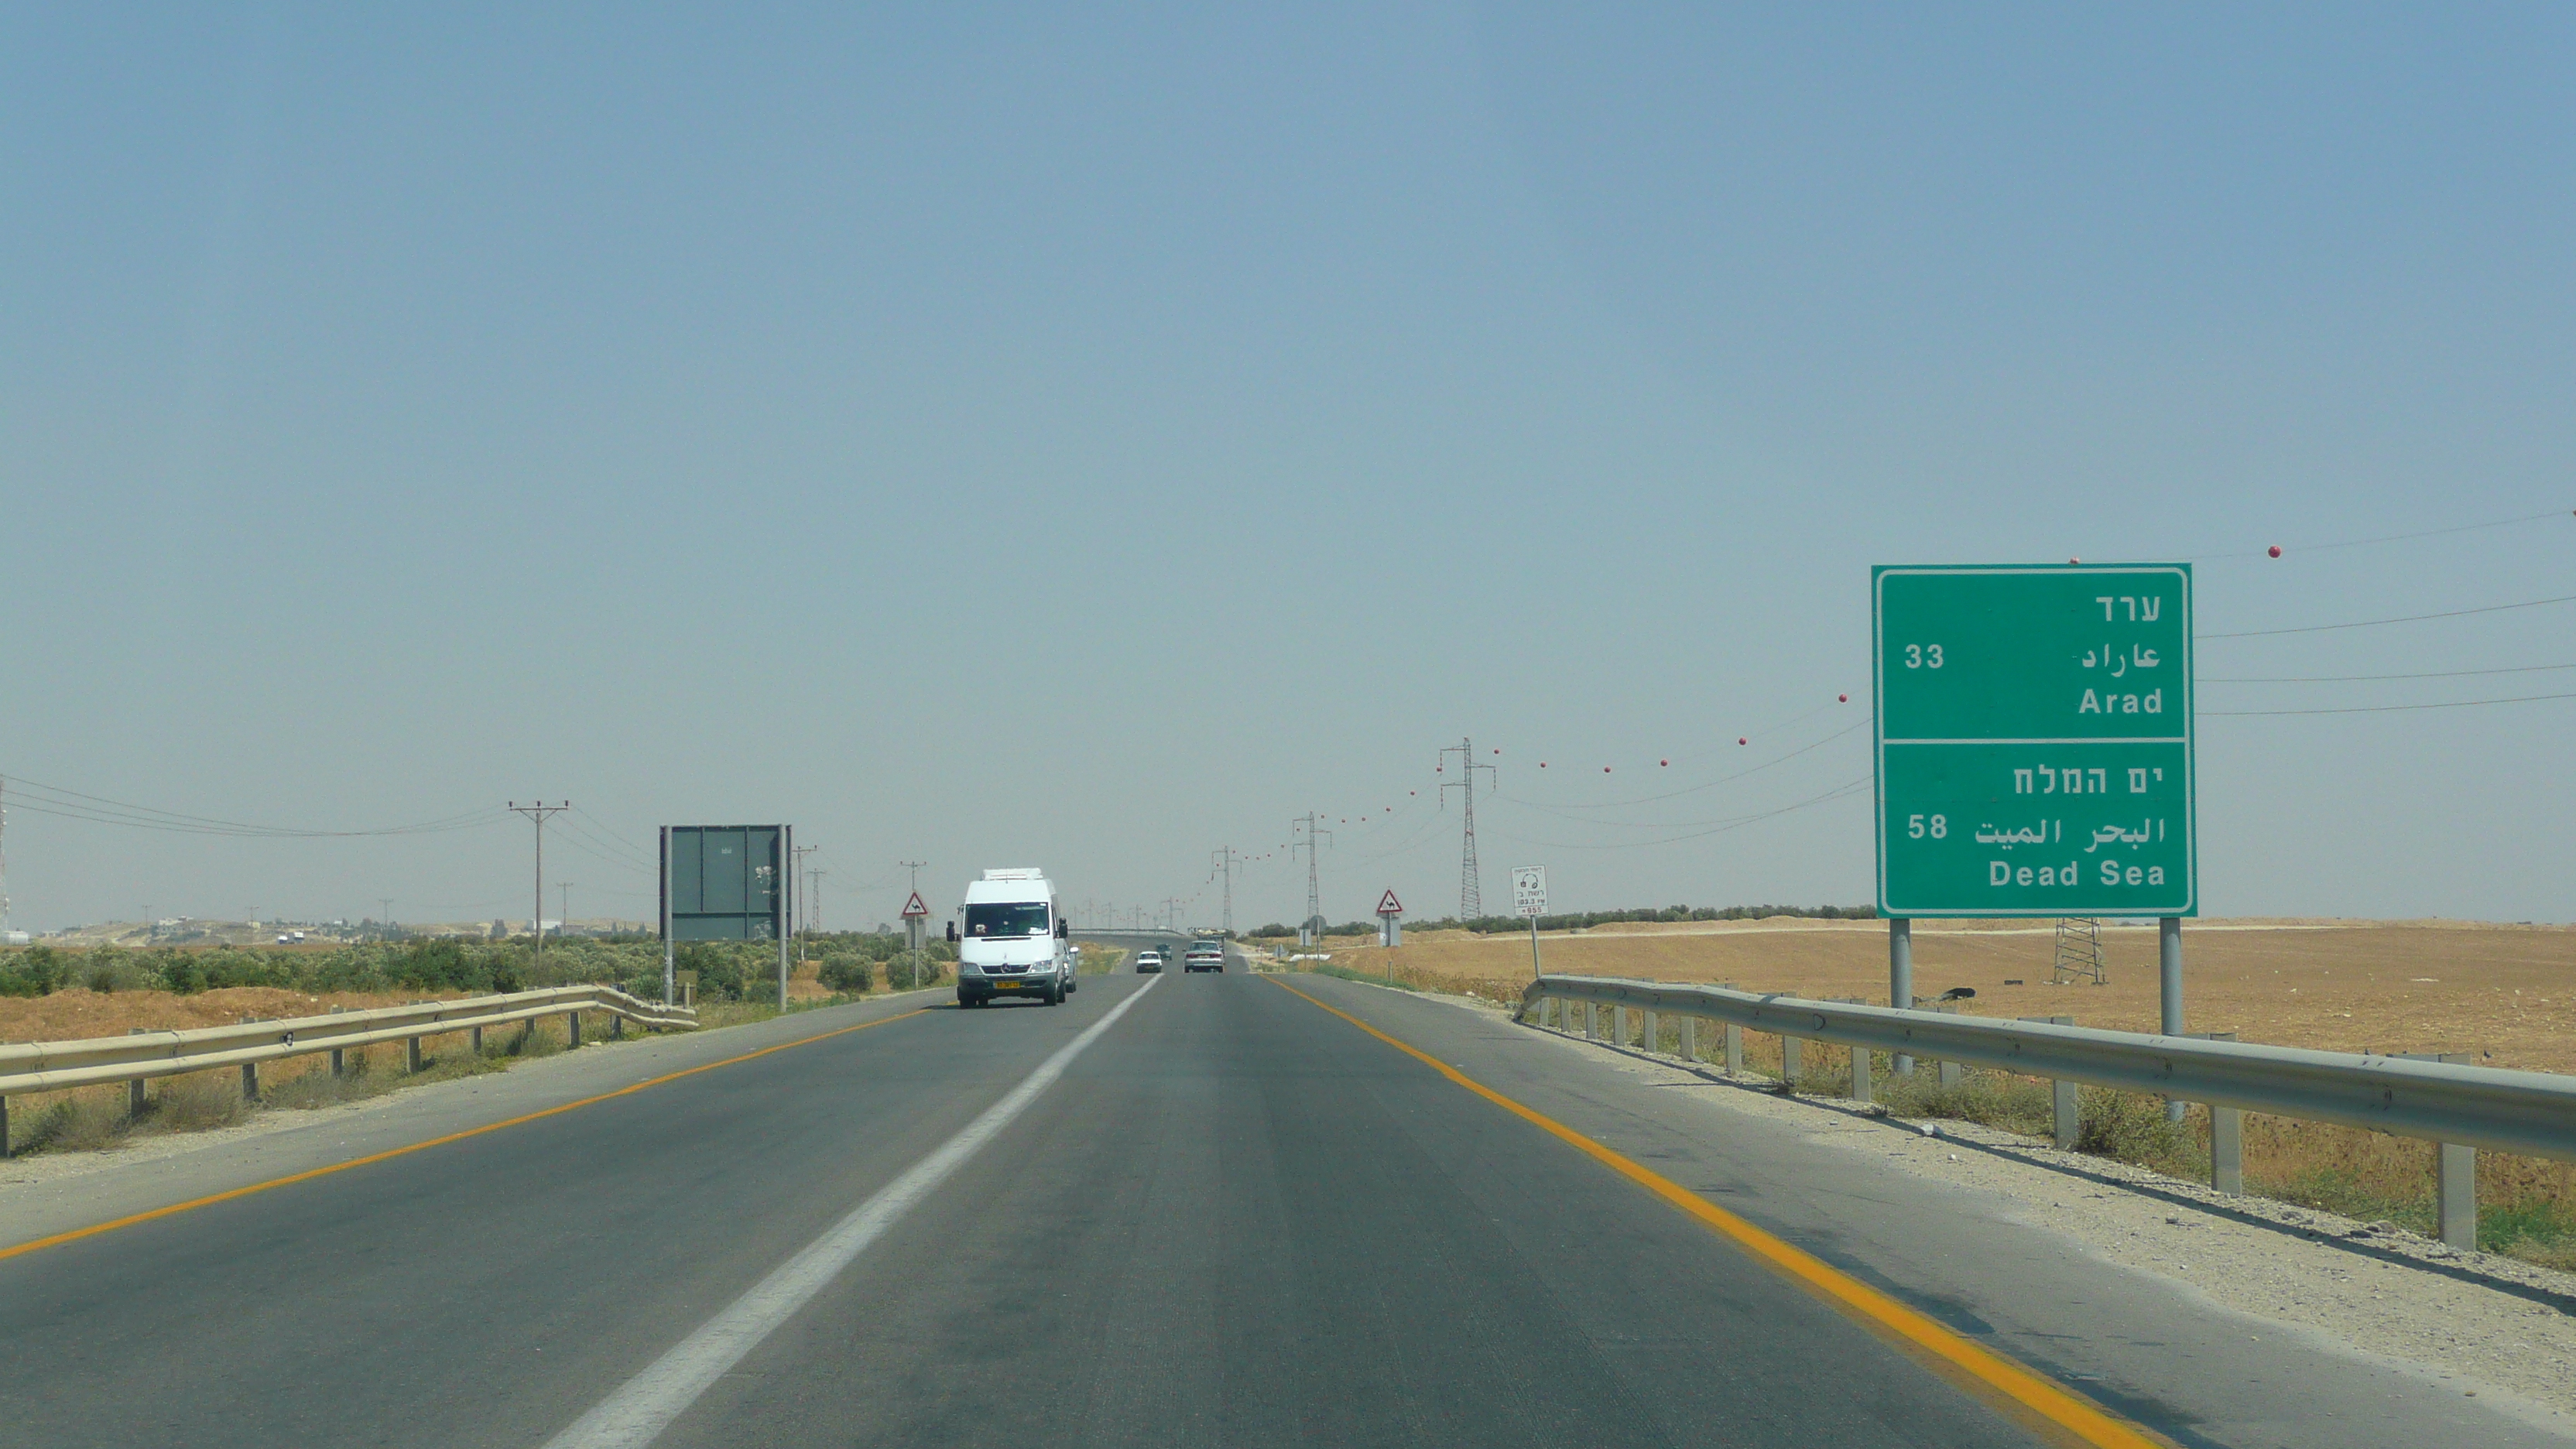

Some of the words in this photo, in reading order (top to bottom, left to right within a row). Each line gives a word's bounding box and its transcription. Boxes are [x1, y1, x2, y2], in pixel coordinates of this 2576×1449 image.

[2096, 596, 2160, 622] ערד
[1905, 644, 1944, 669] 33
[2082, 643, 2160, 677] عاراد
[2079, 688, 2162, 714] Arad
[2014, 764, 2106, 793] המלח
[2128, 768, 2163, 793] ים
[1908, 814, 1947, 839] 58
[1975, 819, 2060, 850] الميت
[2084, 818, 2164, 853] البحر
[1990, 861, 2078, 886] Dead
[2100, 860, 2164, 886] Sea
